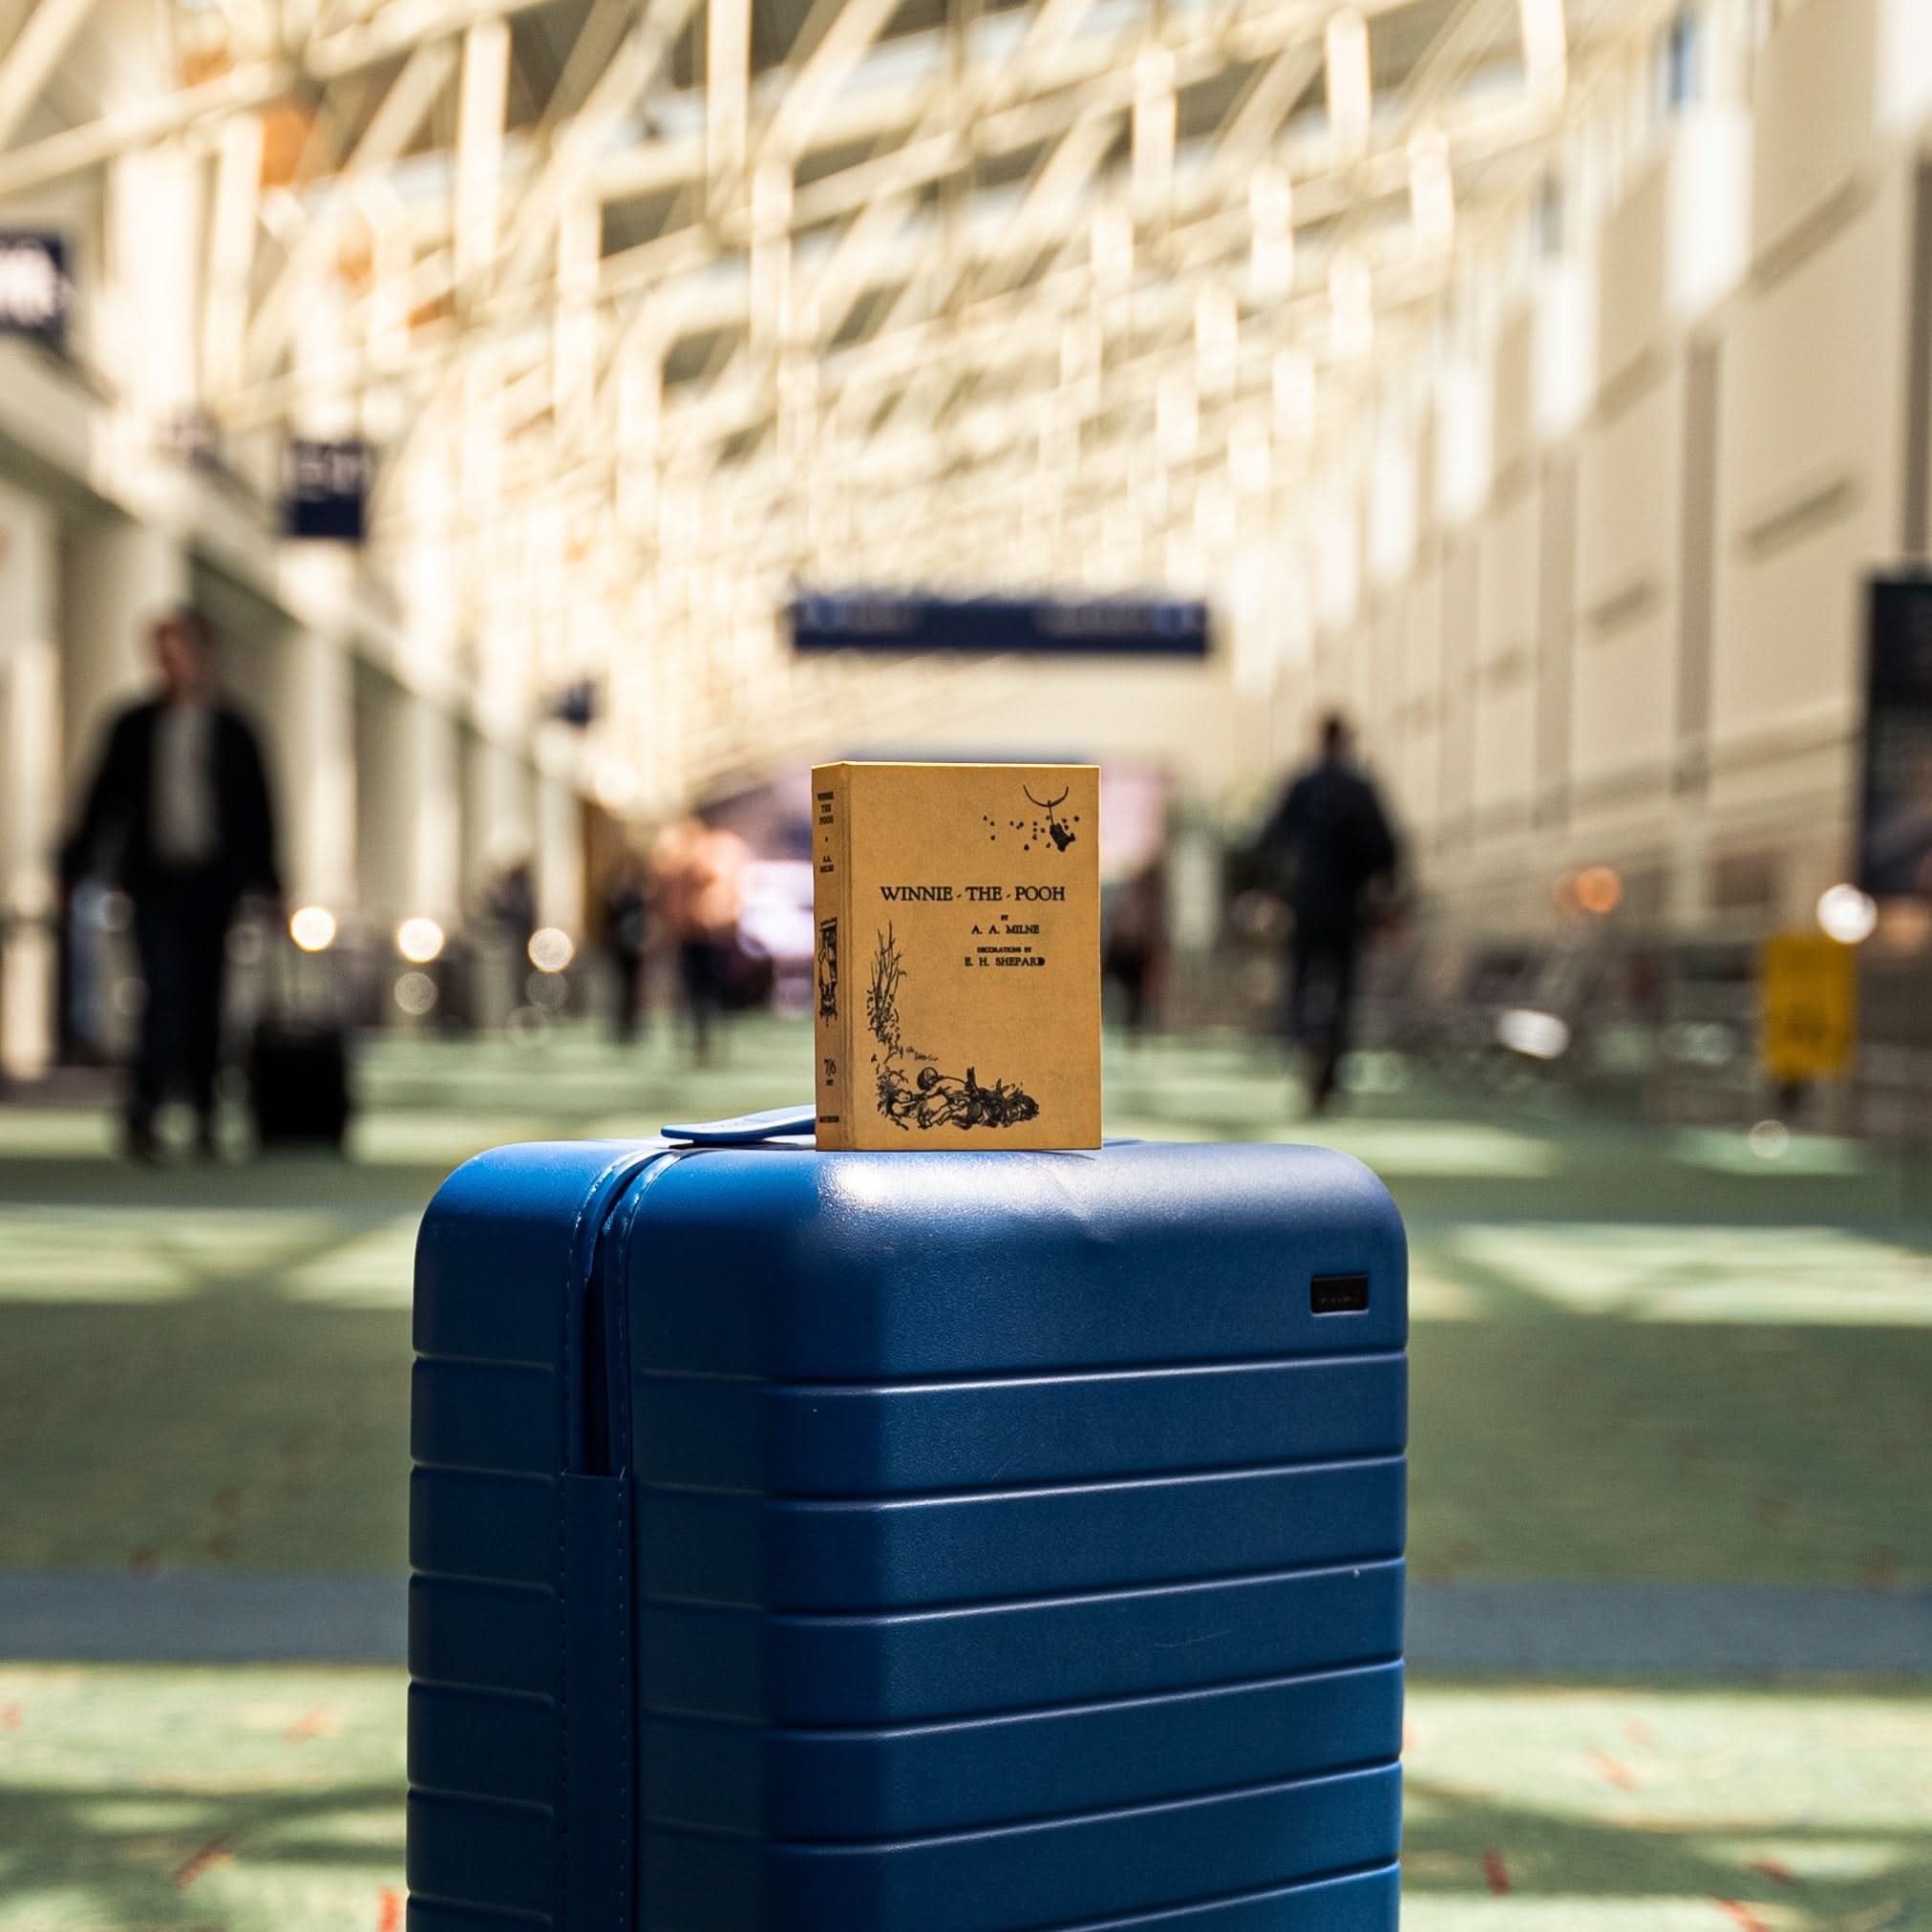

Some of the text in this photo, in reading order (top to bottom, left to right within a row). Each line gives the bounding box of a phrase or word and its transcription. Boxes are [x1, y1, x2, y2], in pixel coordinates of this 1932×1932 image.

[1014, 886, 1065, 901] POOH
[1006, 924, 1039, 934] MILNE
[995, 957, 1046, 966] SHEPARD
